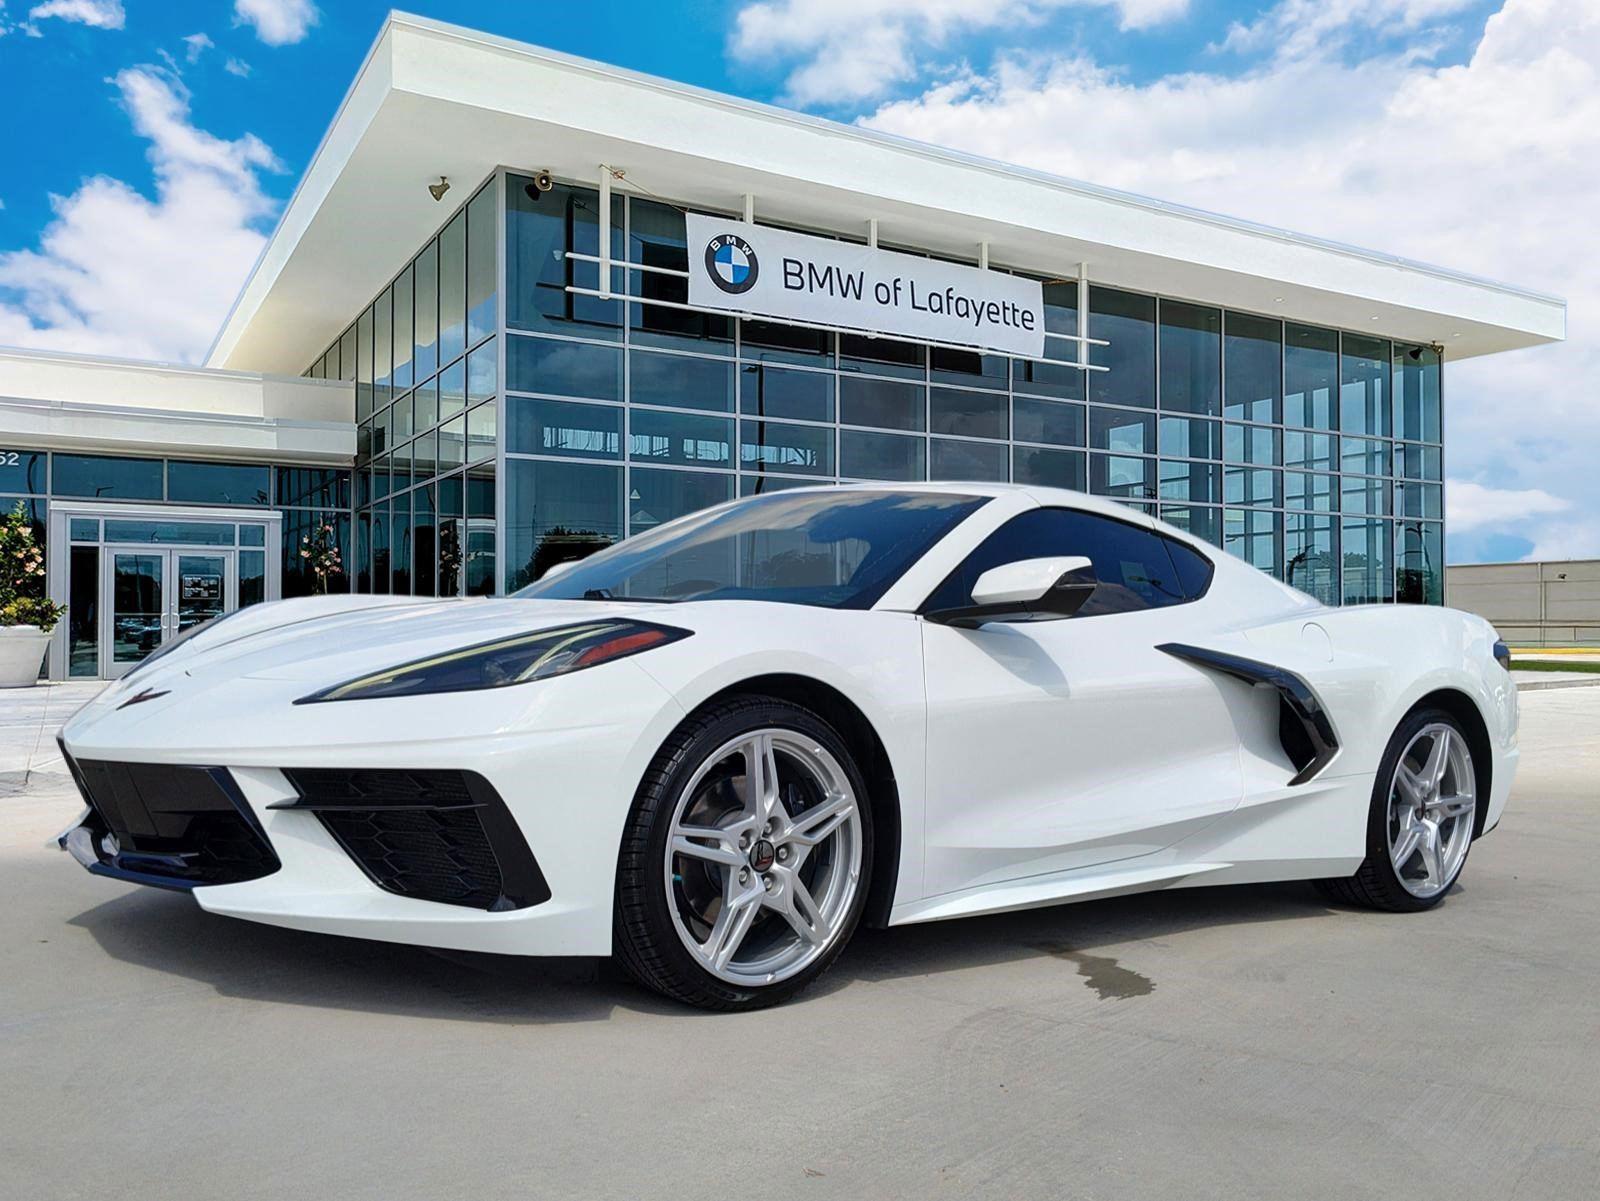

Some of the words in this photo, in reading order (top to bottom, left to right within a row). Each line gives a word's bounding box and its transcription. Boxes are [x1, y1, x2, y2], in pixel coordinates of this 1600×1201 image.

[710, 235, 753, 256] BMW
[782, 257, 865, 301] BMW
[874, 278, 902, 307] of
[910, 280, 1036, 331] Lafayette
